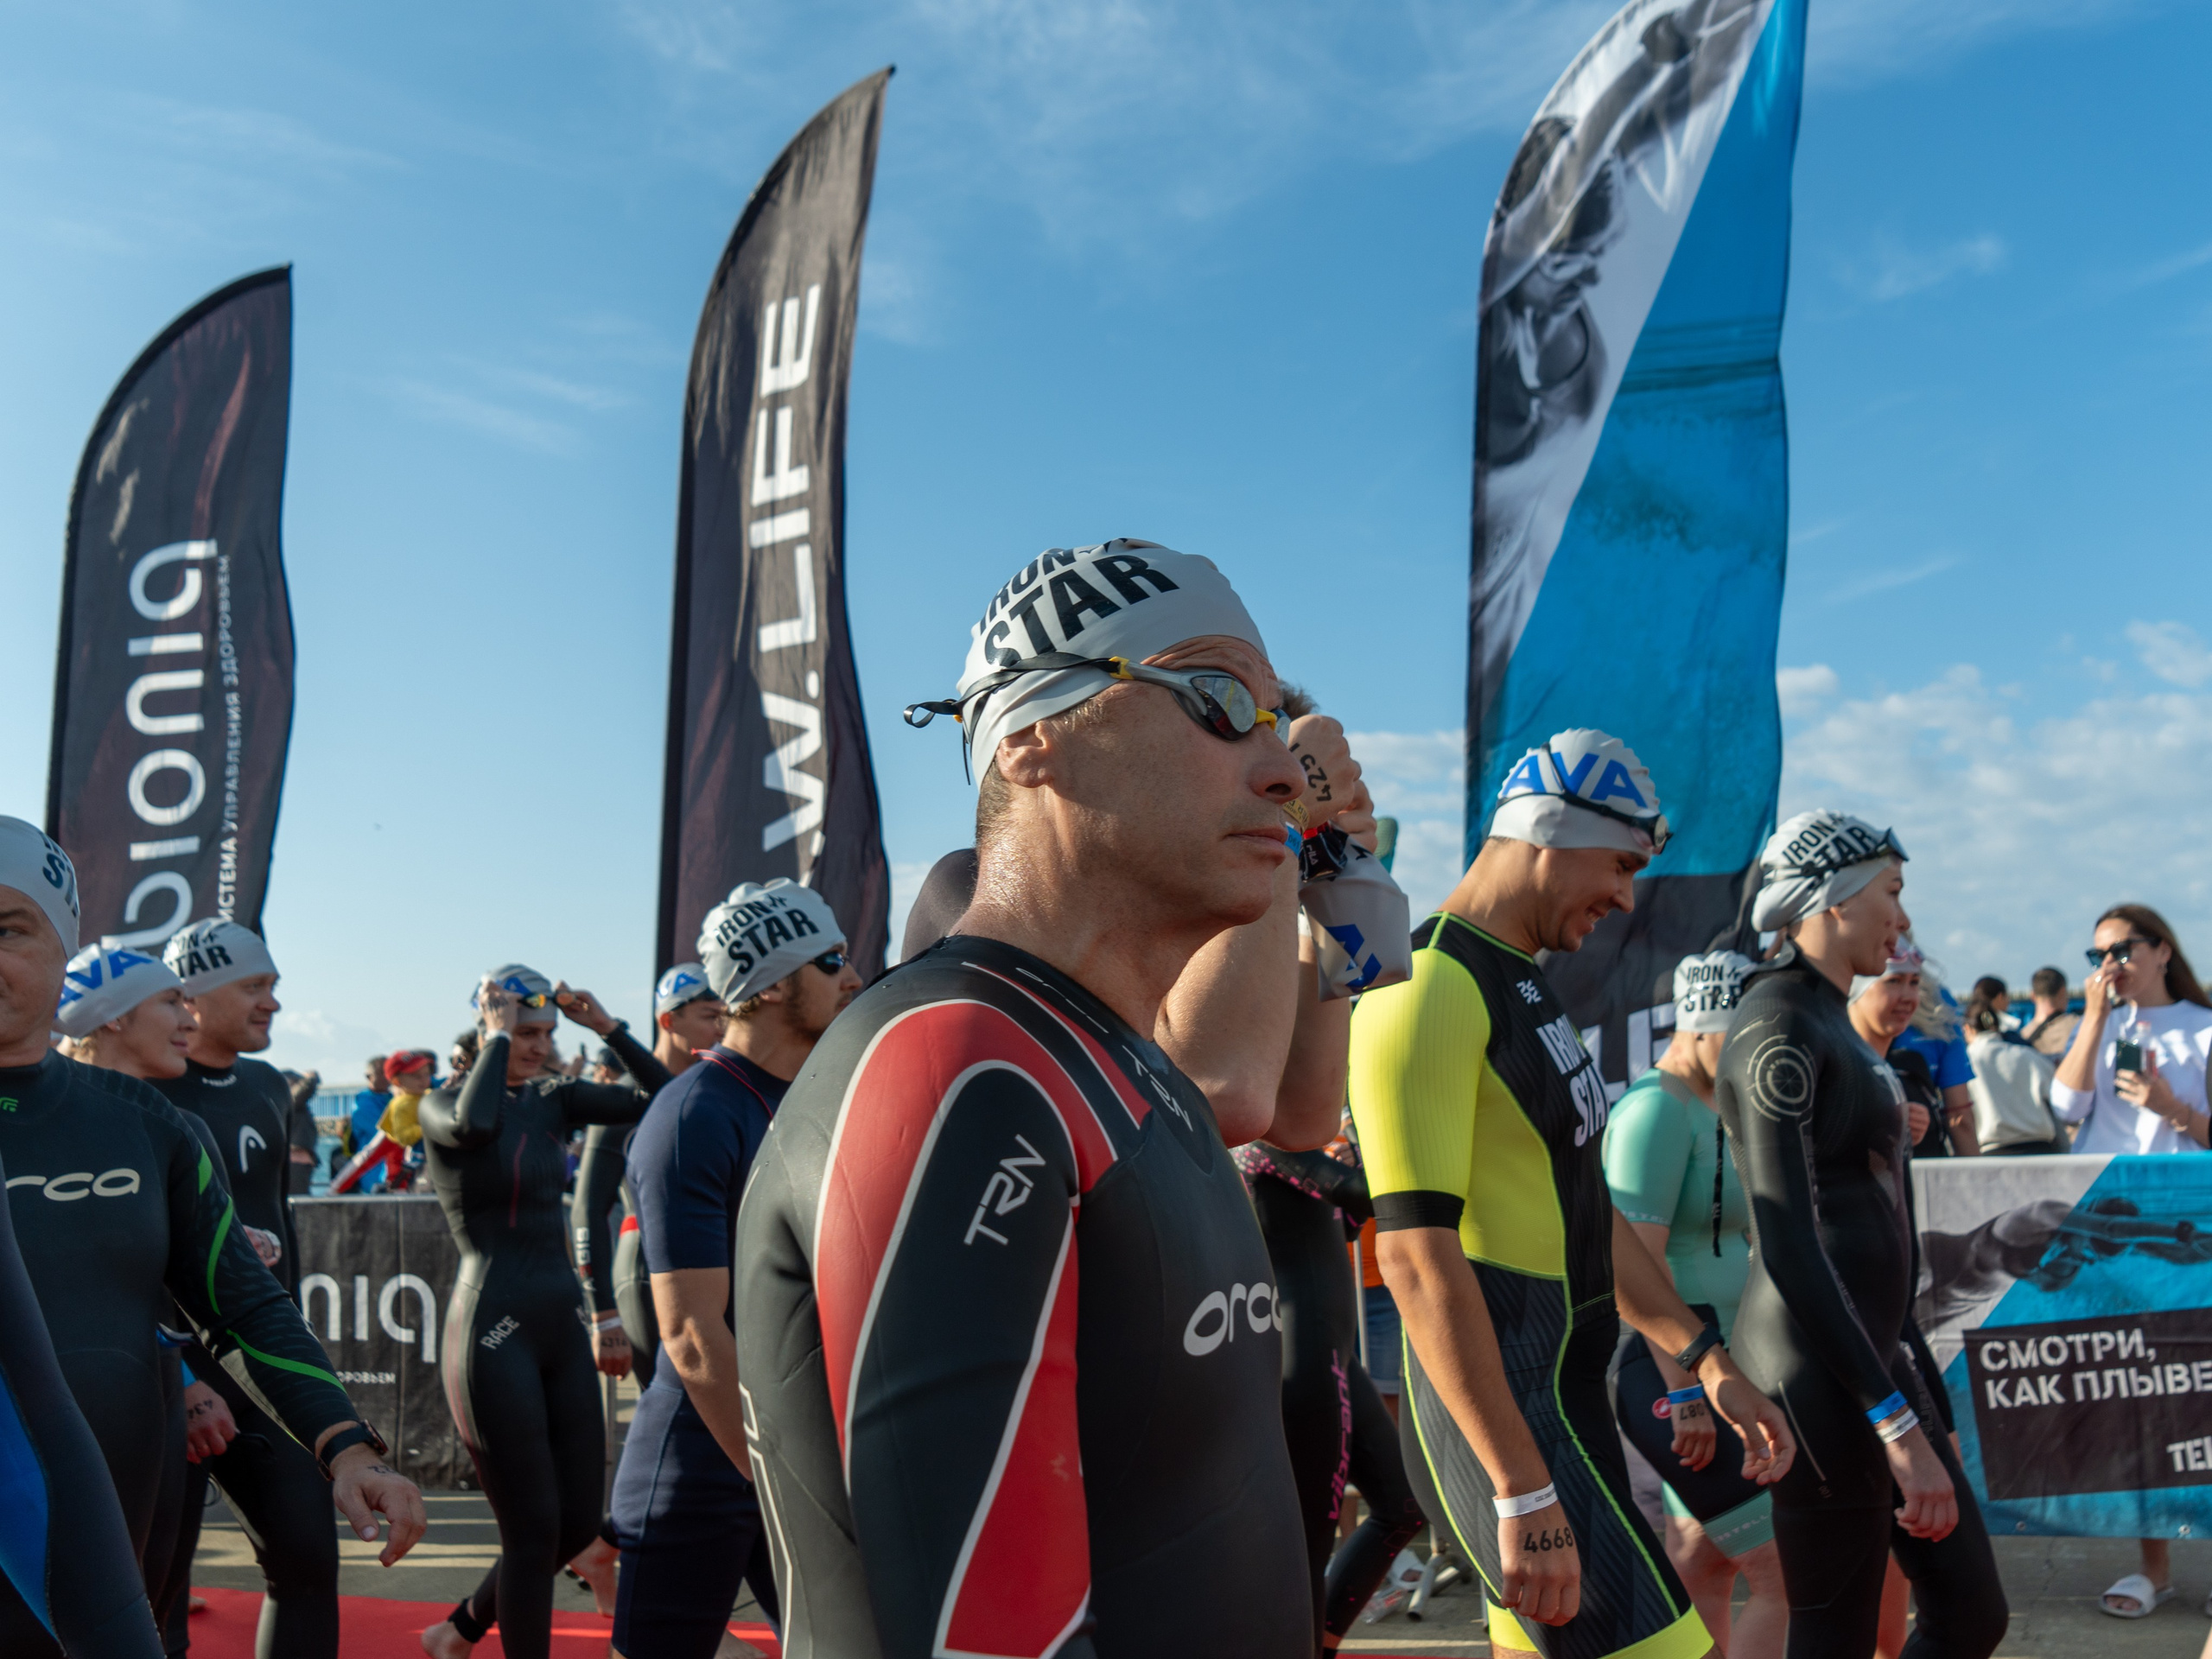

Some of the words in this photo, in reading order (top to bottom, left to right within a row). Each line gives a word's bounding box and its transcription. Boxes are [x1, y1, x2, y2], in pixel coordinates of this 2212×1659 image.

[748, 283, 826, 888] W.LIFE
[984, 555, 1180, 668] STAR
[217, 554, 239, 687] ЗДОРОВЬЕМ
[101, 539, 218, 950] bioniq
[221, 691, 242, 831] УПРАВЛЕНИЯ
[1501, 752, 1647, 808] AVA
[1782, 819, 1837, 865] IRON
[216, 832, 238, 923] ИСТЕМА
[715, 899, 774, 948] IRON
[728, 908, 820, 976] STAR
[168, 944, 233, 978] TAR
[1687, 964, 1725, 983] IRON
[5, 1167, 141, 1202] rca
[963, 1134, 1046, 1245] TRN
[300, 1273, 437, 1363] niq
[480, 1314, 520, 1351] RACE
[1979, 1327, 2157, 1372] СМОТРИ,
[1985, 1374, 2066, 1410] КАК
[2071, 1359, 2212, 1402] ПЛЫВЕ
[1328, 1349, 1353, 1520] vibrant
[1523, 1526, 1573, 1553] 4668
